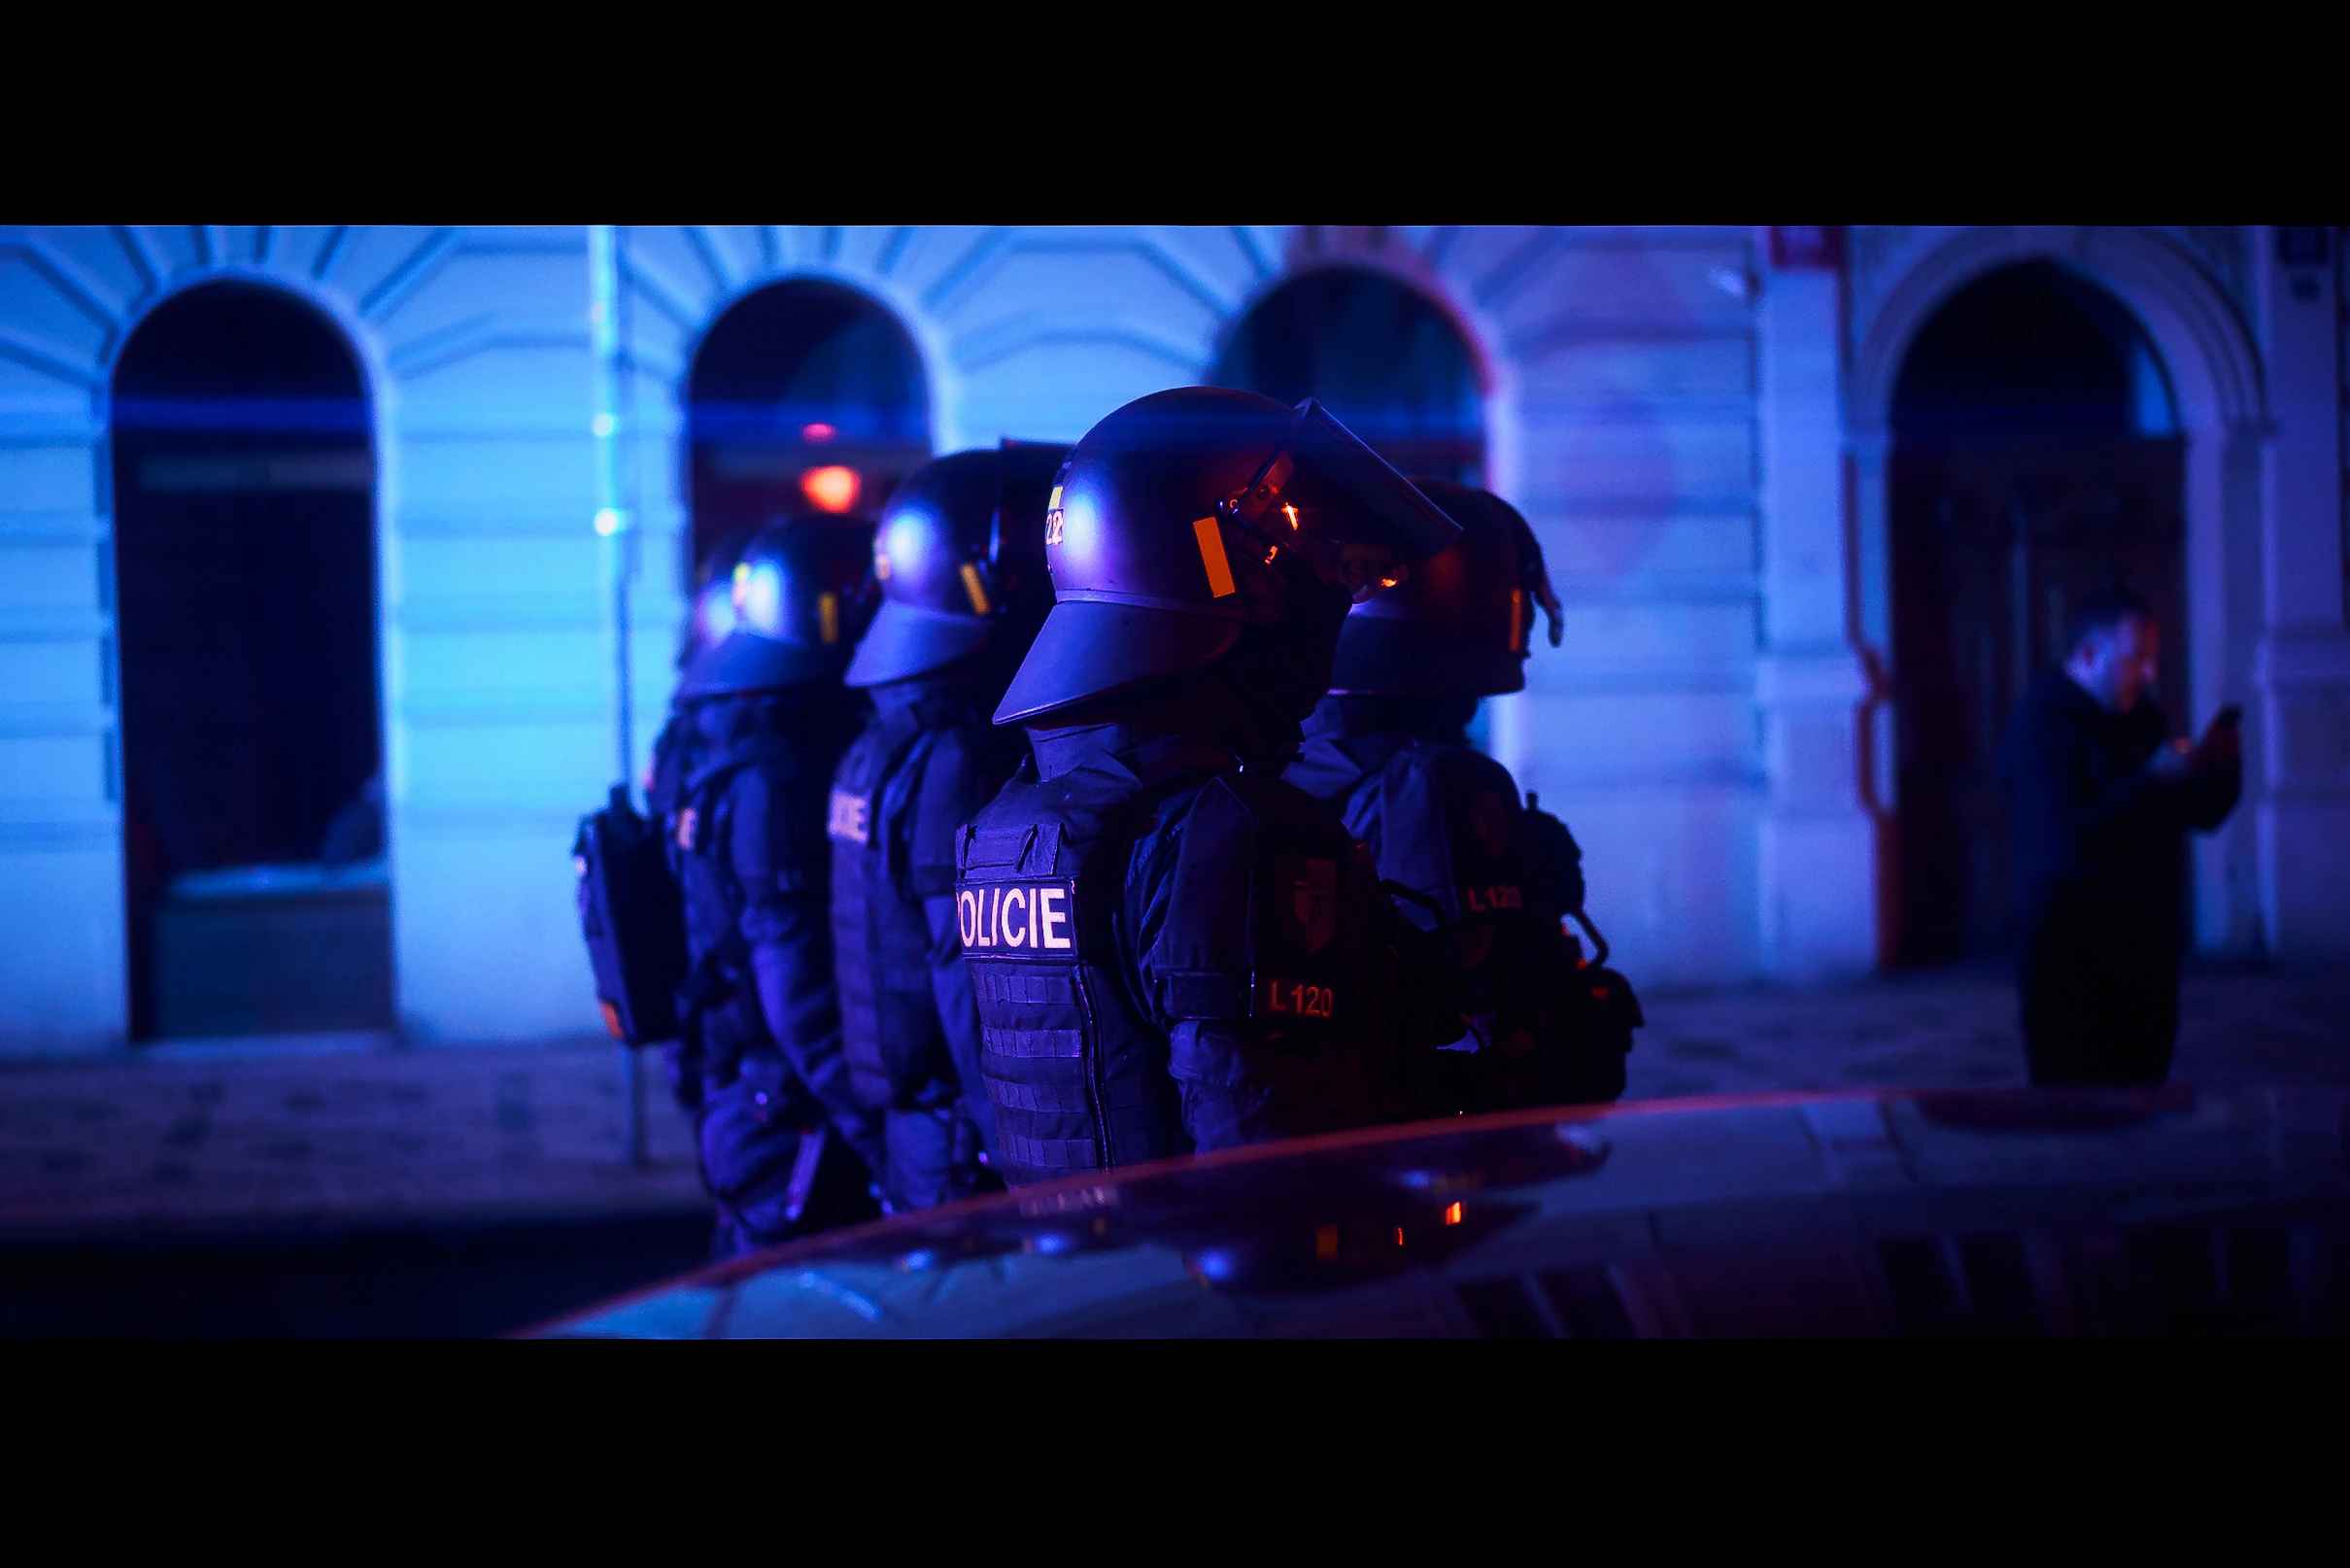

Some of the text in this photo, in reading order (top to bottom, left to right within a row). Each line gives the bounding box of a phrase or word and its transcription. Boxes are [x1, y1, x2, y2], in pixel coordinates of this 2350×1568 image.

[957, 888, 1072, 949] OLICIE
[1270, 981, 1333, 1018] L 120
